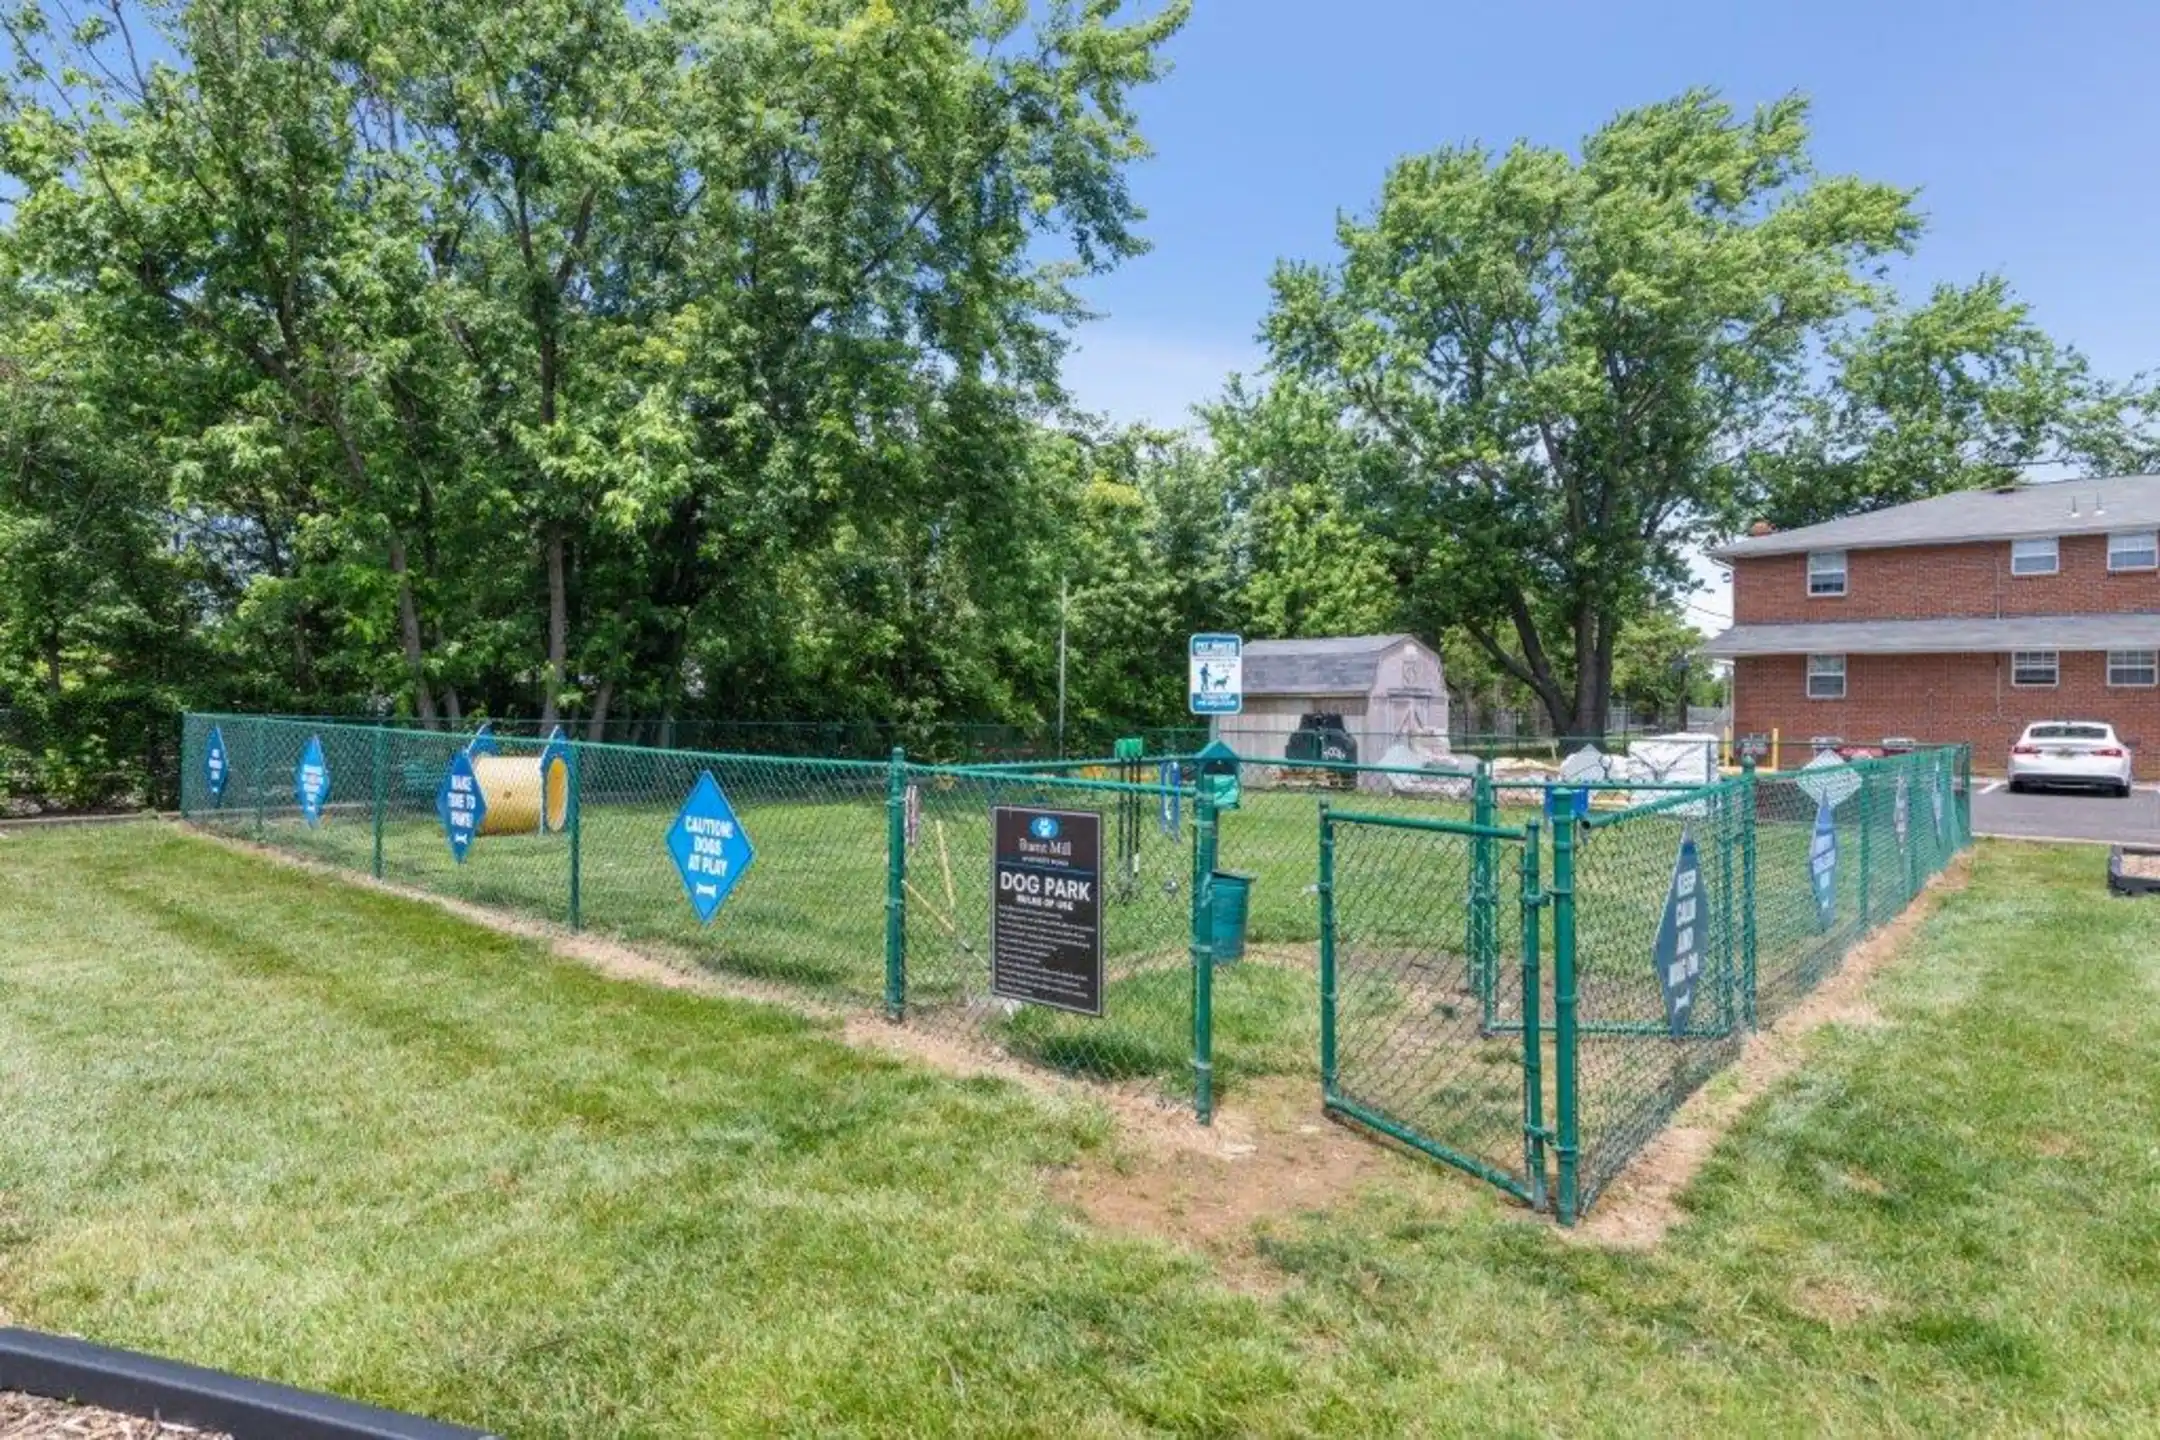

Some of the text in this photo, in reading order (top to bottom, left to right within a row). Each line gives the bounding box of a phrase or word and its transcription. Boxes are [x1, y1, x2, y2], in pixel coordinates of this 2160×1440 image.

[694, 835, 722, 857] DOGS
[688, 853, 728, 877] AT PLAY
[1000, 871, 1091, 901] DOG PARK
